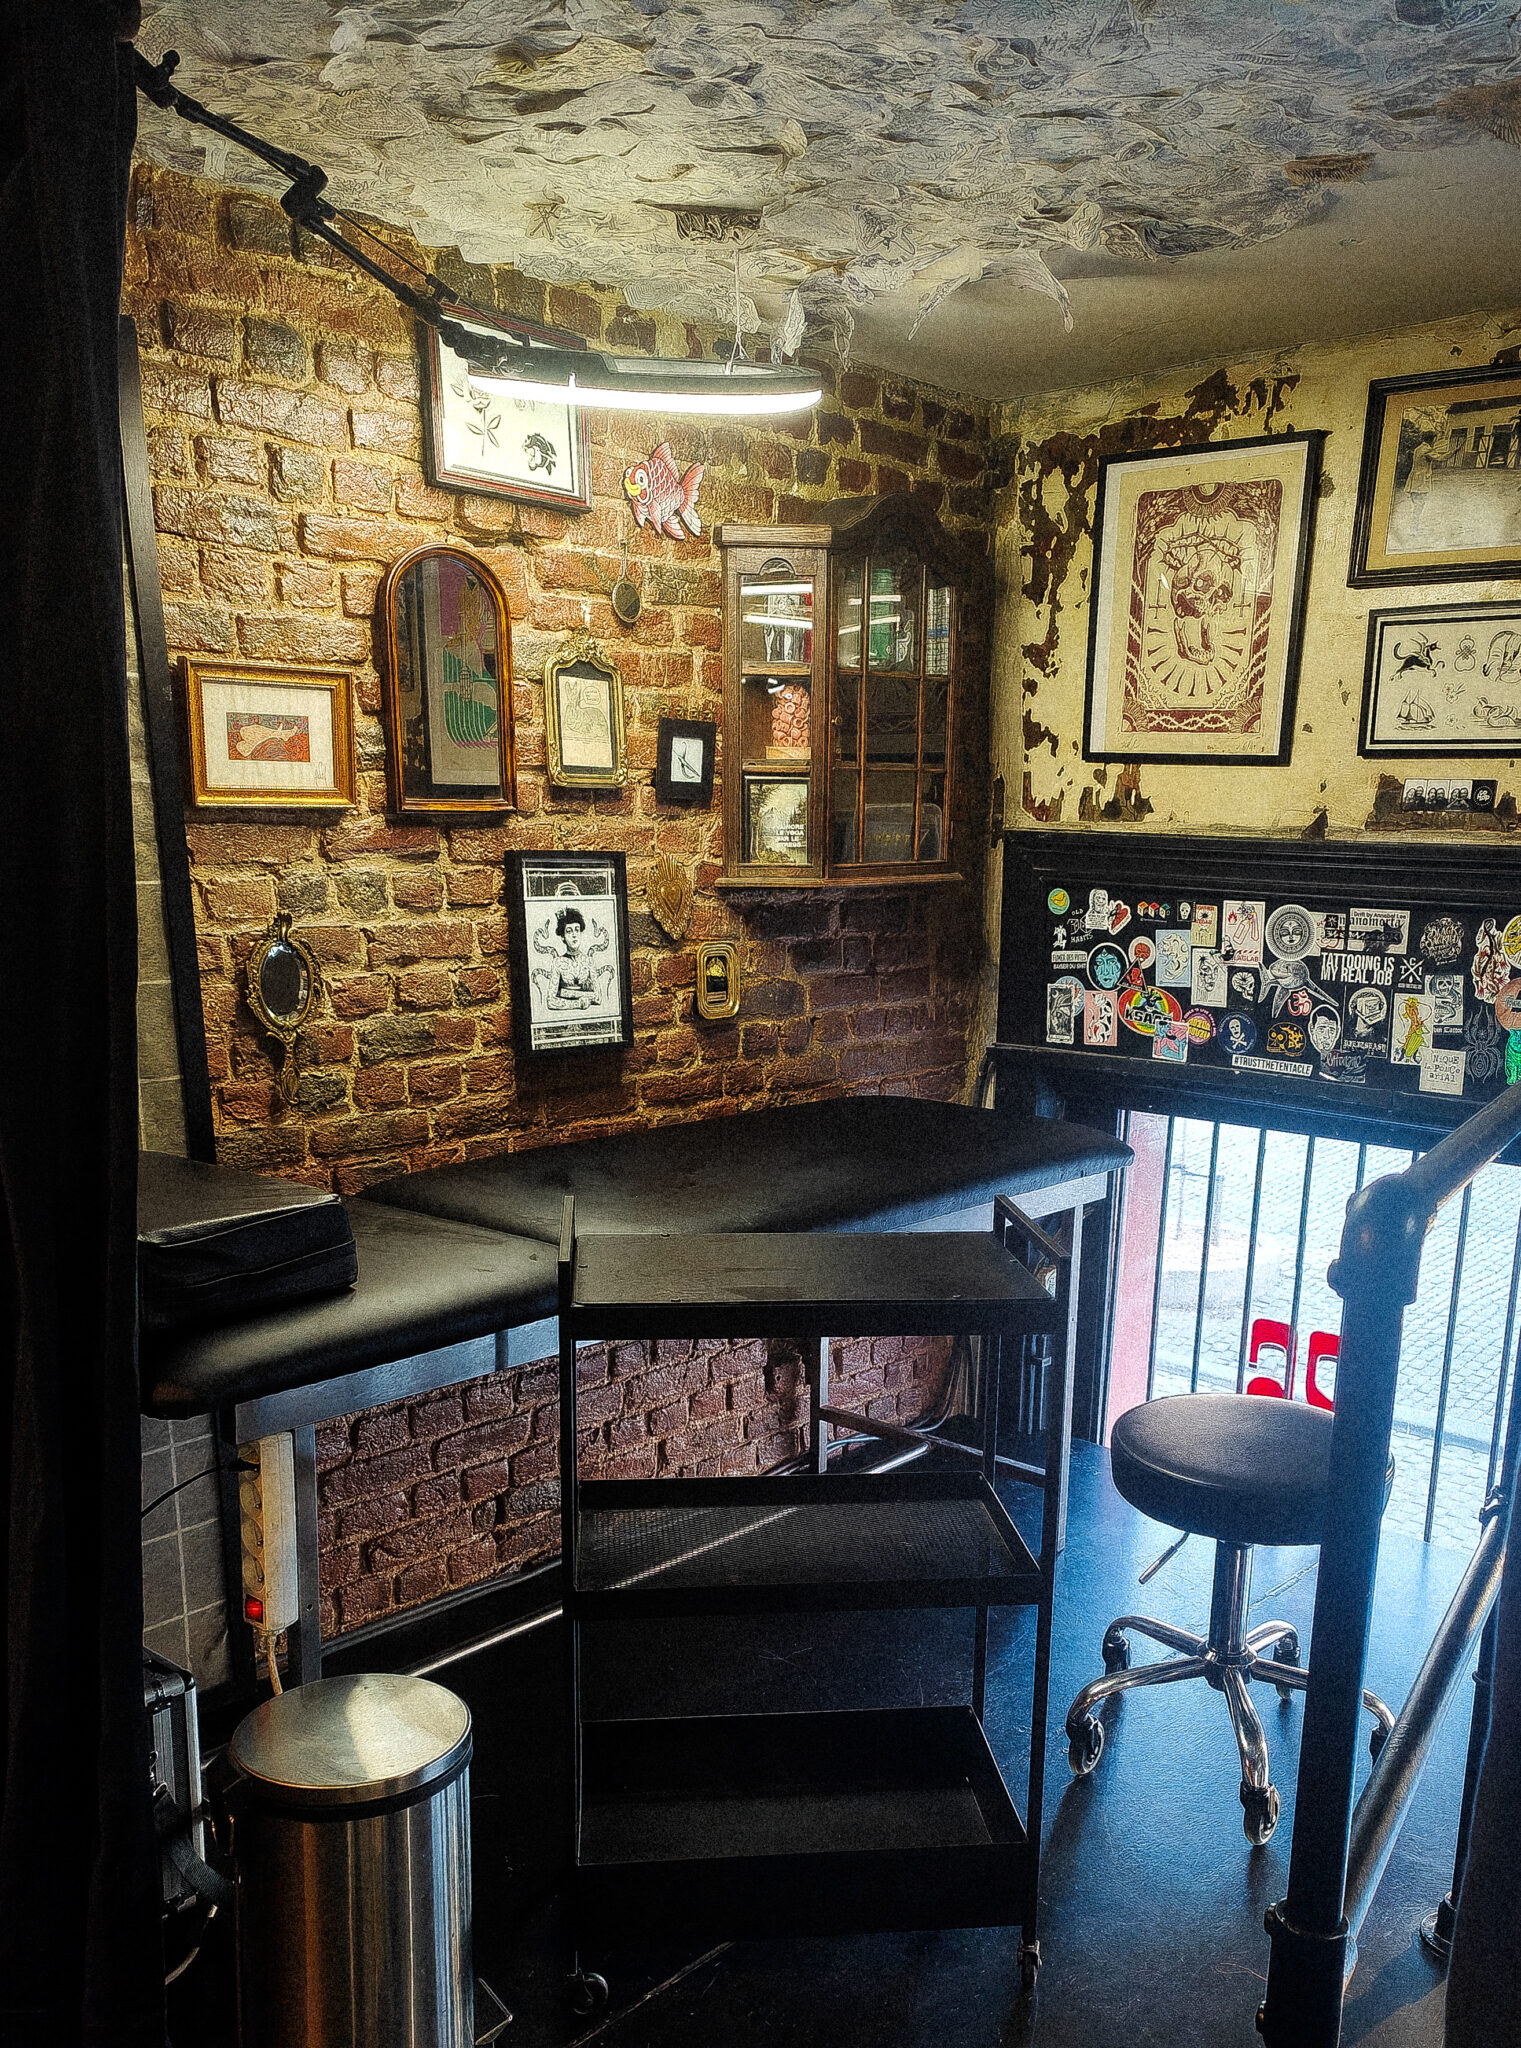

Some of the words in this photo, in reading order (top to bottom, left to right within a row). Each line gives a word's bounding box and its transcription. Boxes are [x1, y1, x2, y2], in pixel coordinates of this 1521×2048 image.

[1366, 911, 1373, 919] by
[1373, 911, 1396, 919] Annabel
[1396, 913, 1407, 921] Lee
[1321, 952, 1381, 971] TATTOOING
[1384, 956, 1395, 973] IS
[1409, 957, 1417, 966] C
[1320, 965, 1338, 981] MY
[1340, 967, 1369, 984] REAL
[1371, 970, 1393, 986] JOB
[1399, 965, 1407, 975] T
[1233, 1056, 1311, 1075] #TRUSTTHETENTACLE
